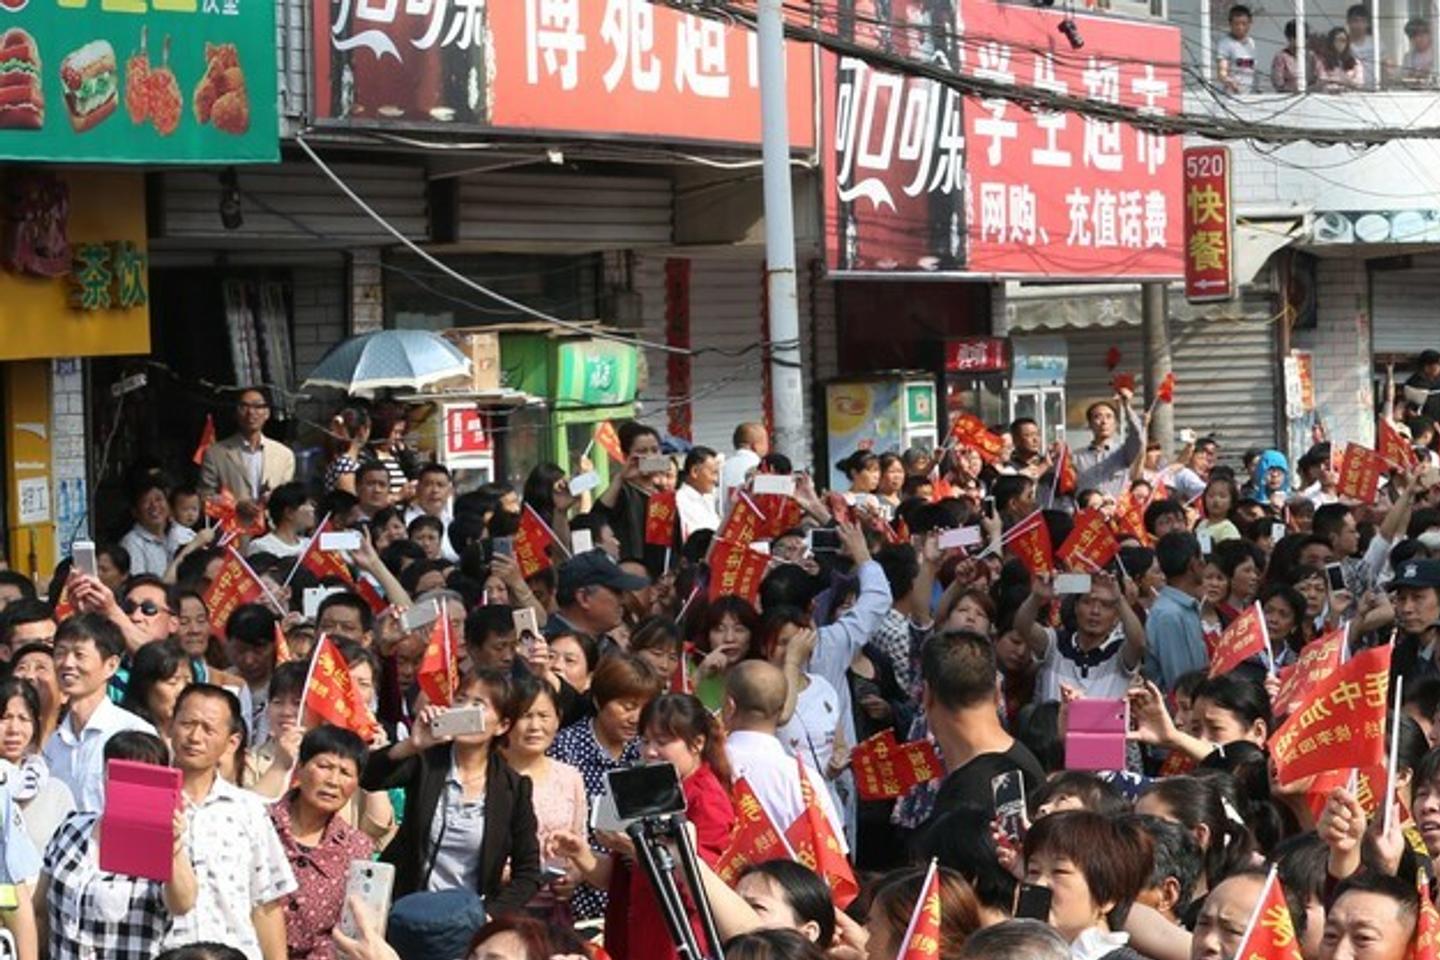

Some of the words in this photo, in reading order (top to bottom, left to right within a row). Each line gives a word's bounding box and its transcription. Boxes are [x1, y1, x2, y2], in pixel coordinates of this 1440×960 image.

[525, 0, 787, 98] 博苑超
[972, 42, 1169, 174] 学生超市
[1187, 154, 1222, 178] 520
[981, 183, 1167, 249] 网购、充值话费
[1188, 185, 1225, 272] 快餐
